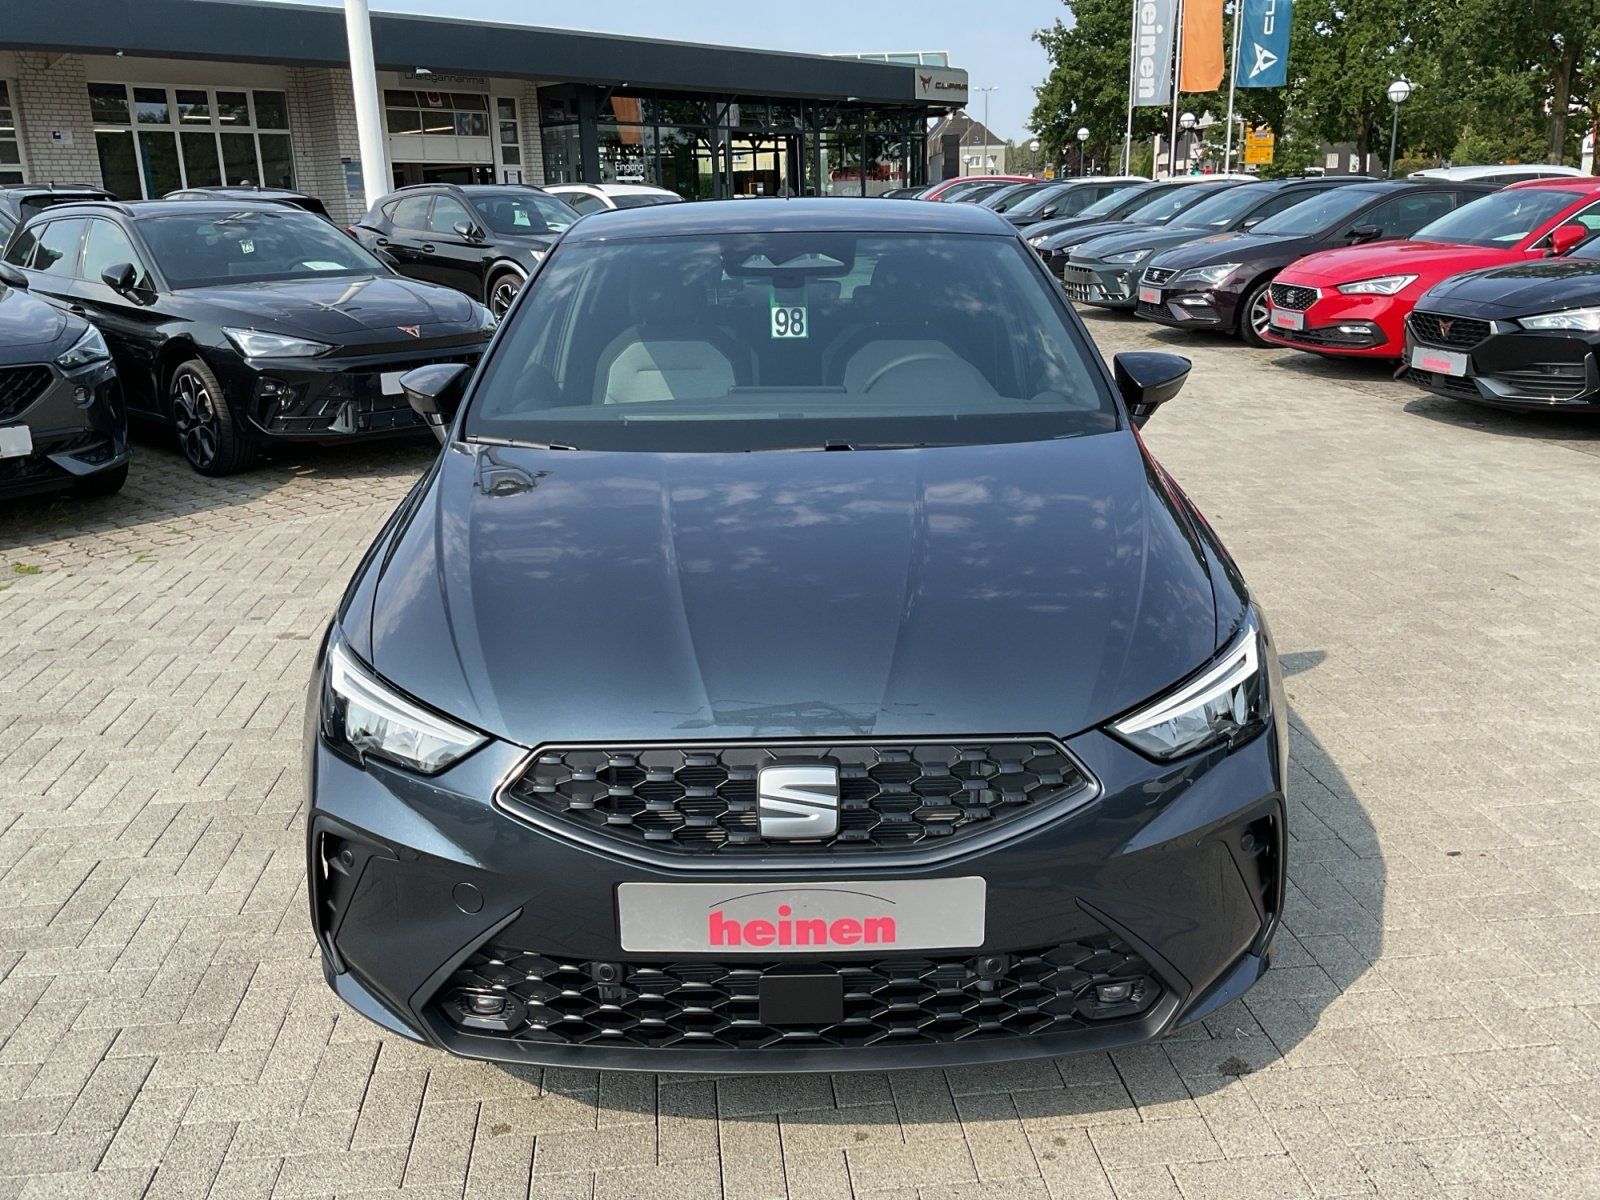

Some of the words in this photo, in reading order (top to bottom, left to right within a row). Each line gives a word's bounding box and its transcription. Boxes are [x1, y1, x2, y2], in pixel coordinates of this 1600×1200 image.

[1138, 0, 1163, 98] einen
[615, 161, 644, 173] Eingang
[775, 308, 804, 336] 98
[709, 904, 896, 946] heinen
